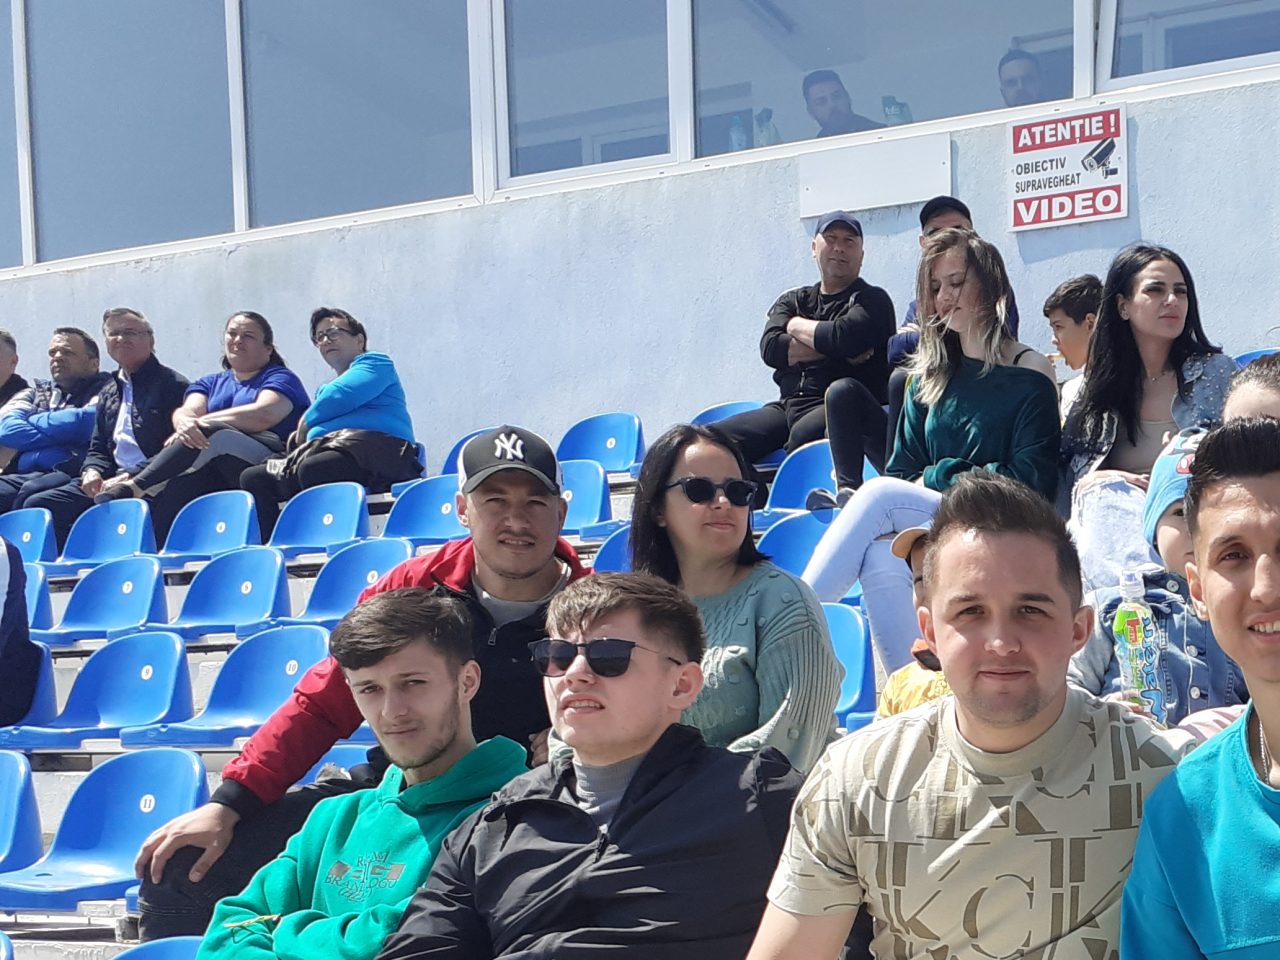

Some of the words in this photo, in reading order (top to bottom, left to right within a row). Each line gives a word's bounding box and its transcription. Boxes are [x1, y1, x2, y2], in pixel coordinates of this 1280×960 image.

[1016, 157, 1066, 176] OBIECTIV
[1015, 172, 1081, 194] SUPRAVEGHEAT
[1017, 189, 1118, 224] VIDEO
[143, 798, 152, 809] 11
